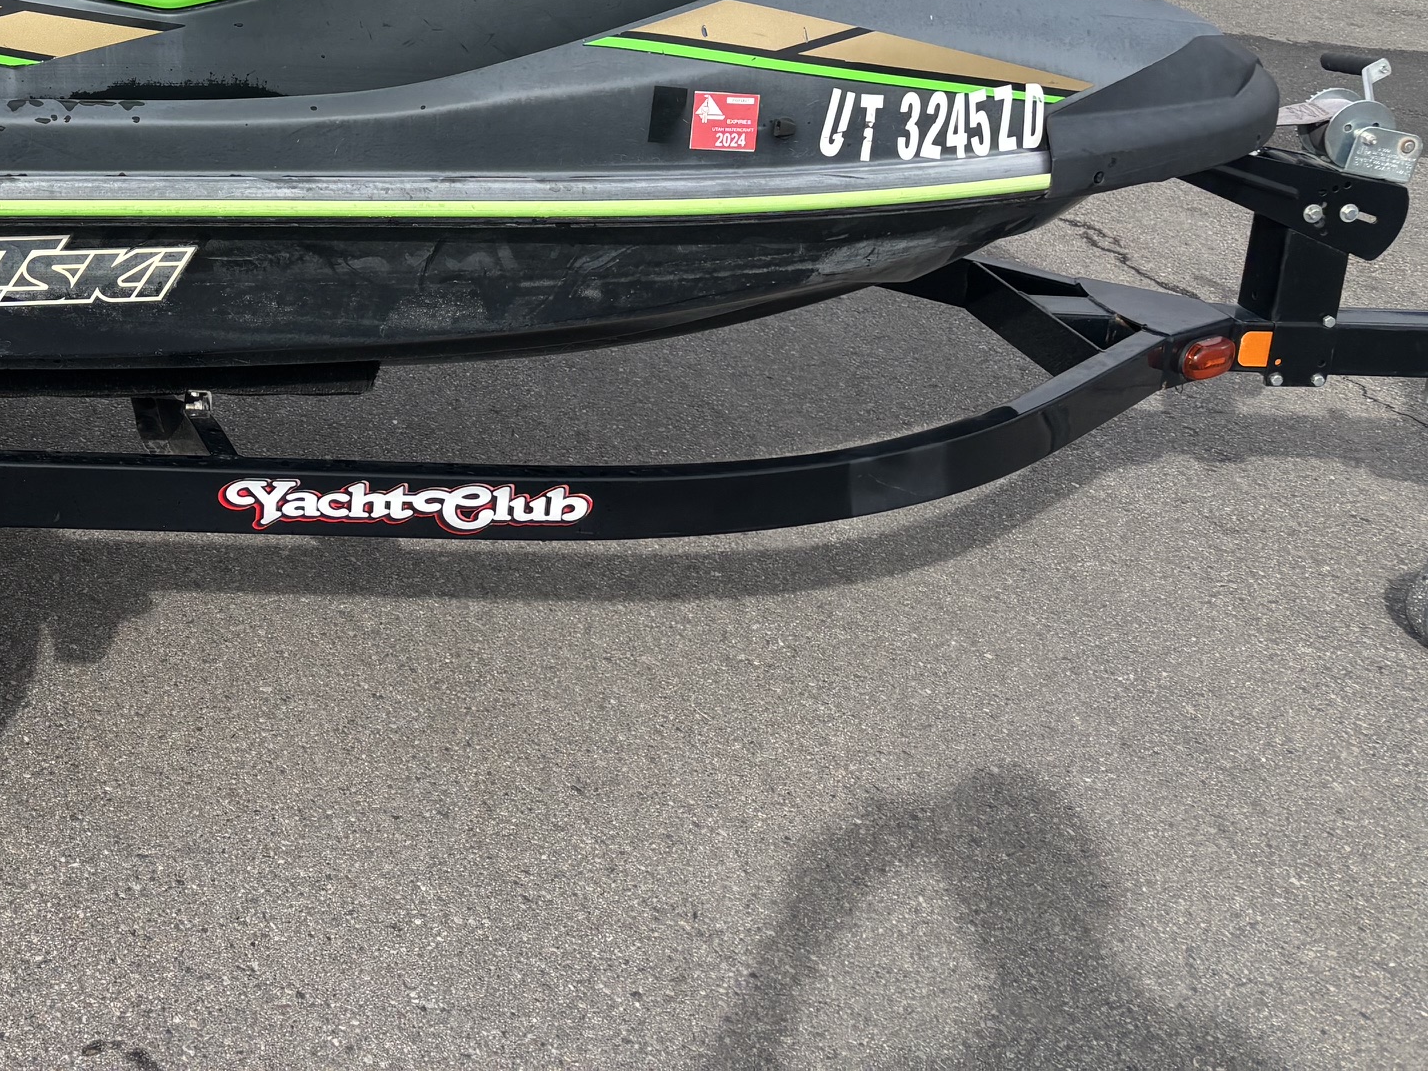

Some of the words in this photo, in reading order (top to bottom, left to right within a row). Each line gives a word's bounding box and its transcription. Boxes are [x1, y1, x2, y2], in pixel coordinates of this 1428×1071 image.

[714, 132, 746, 147] 2024
[218, 478, 415, 529] Yacht
[415, 482, 594, 535] Club
